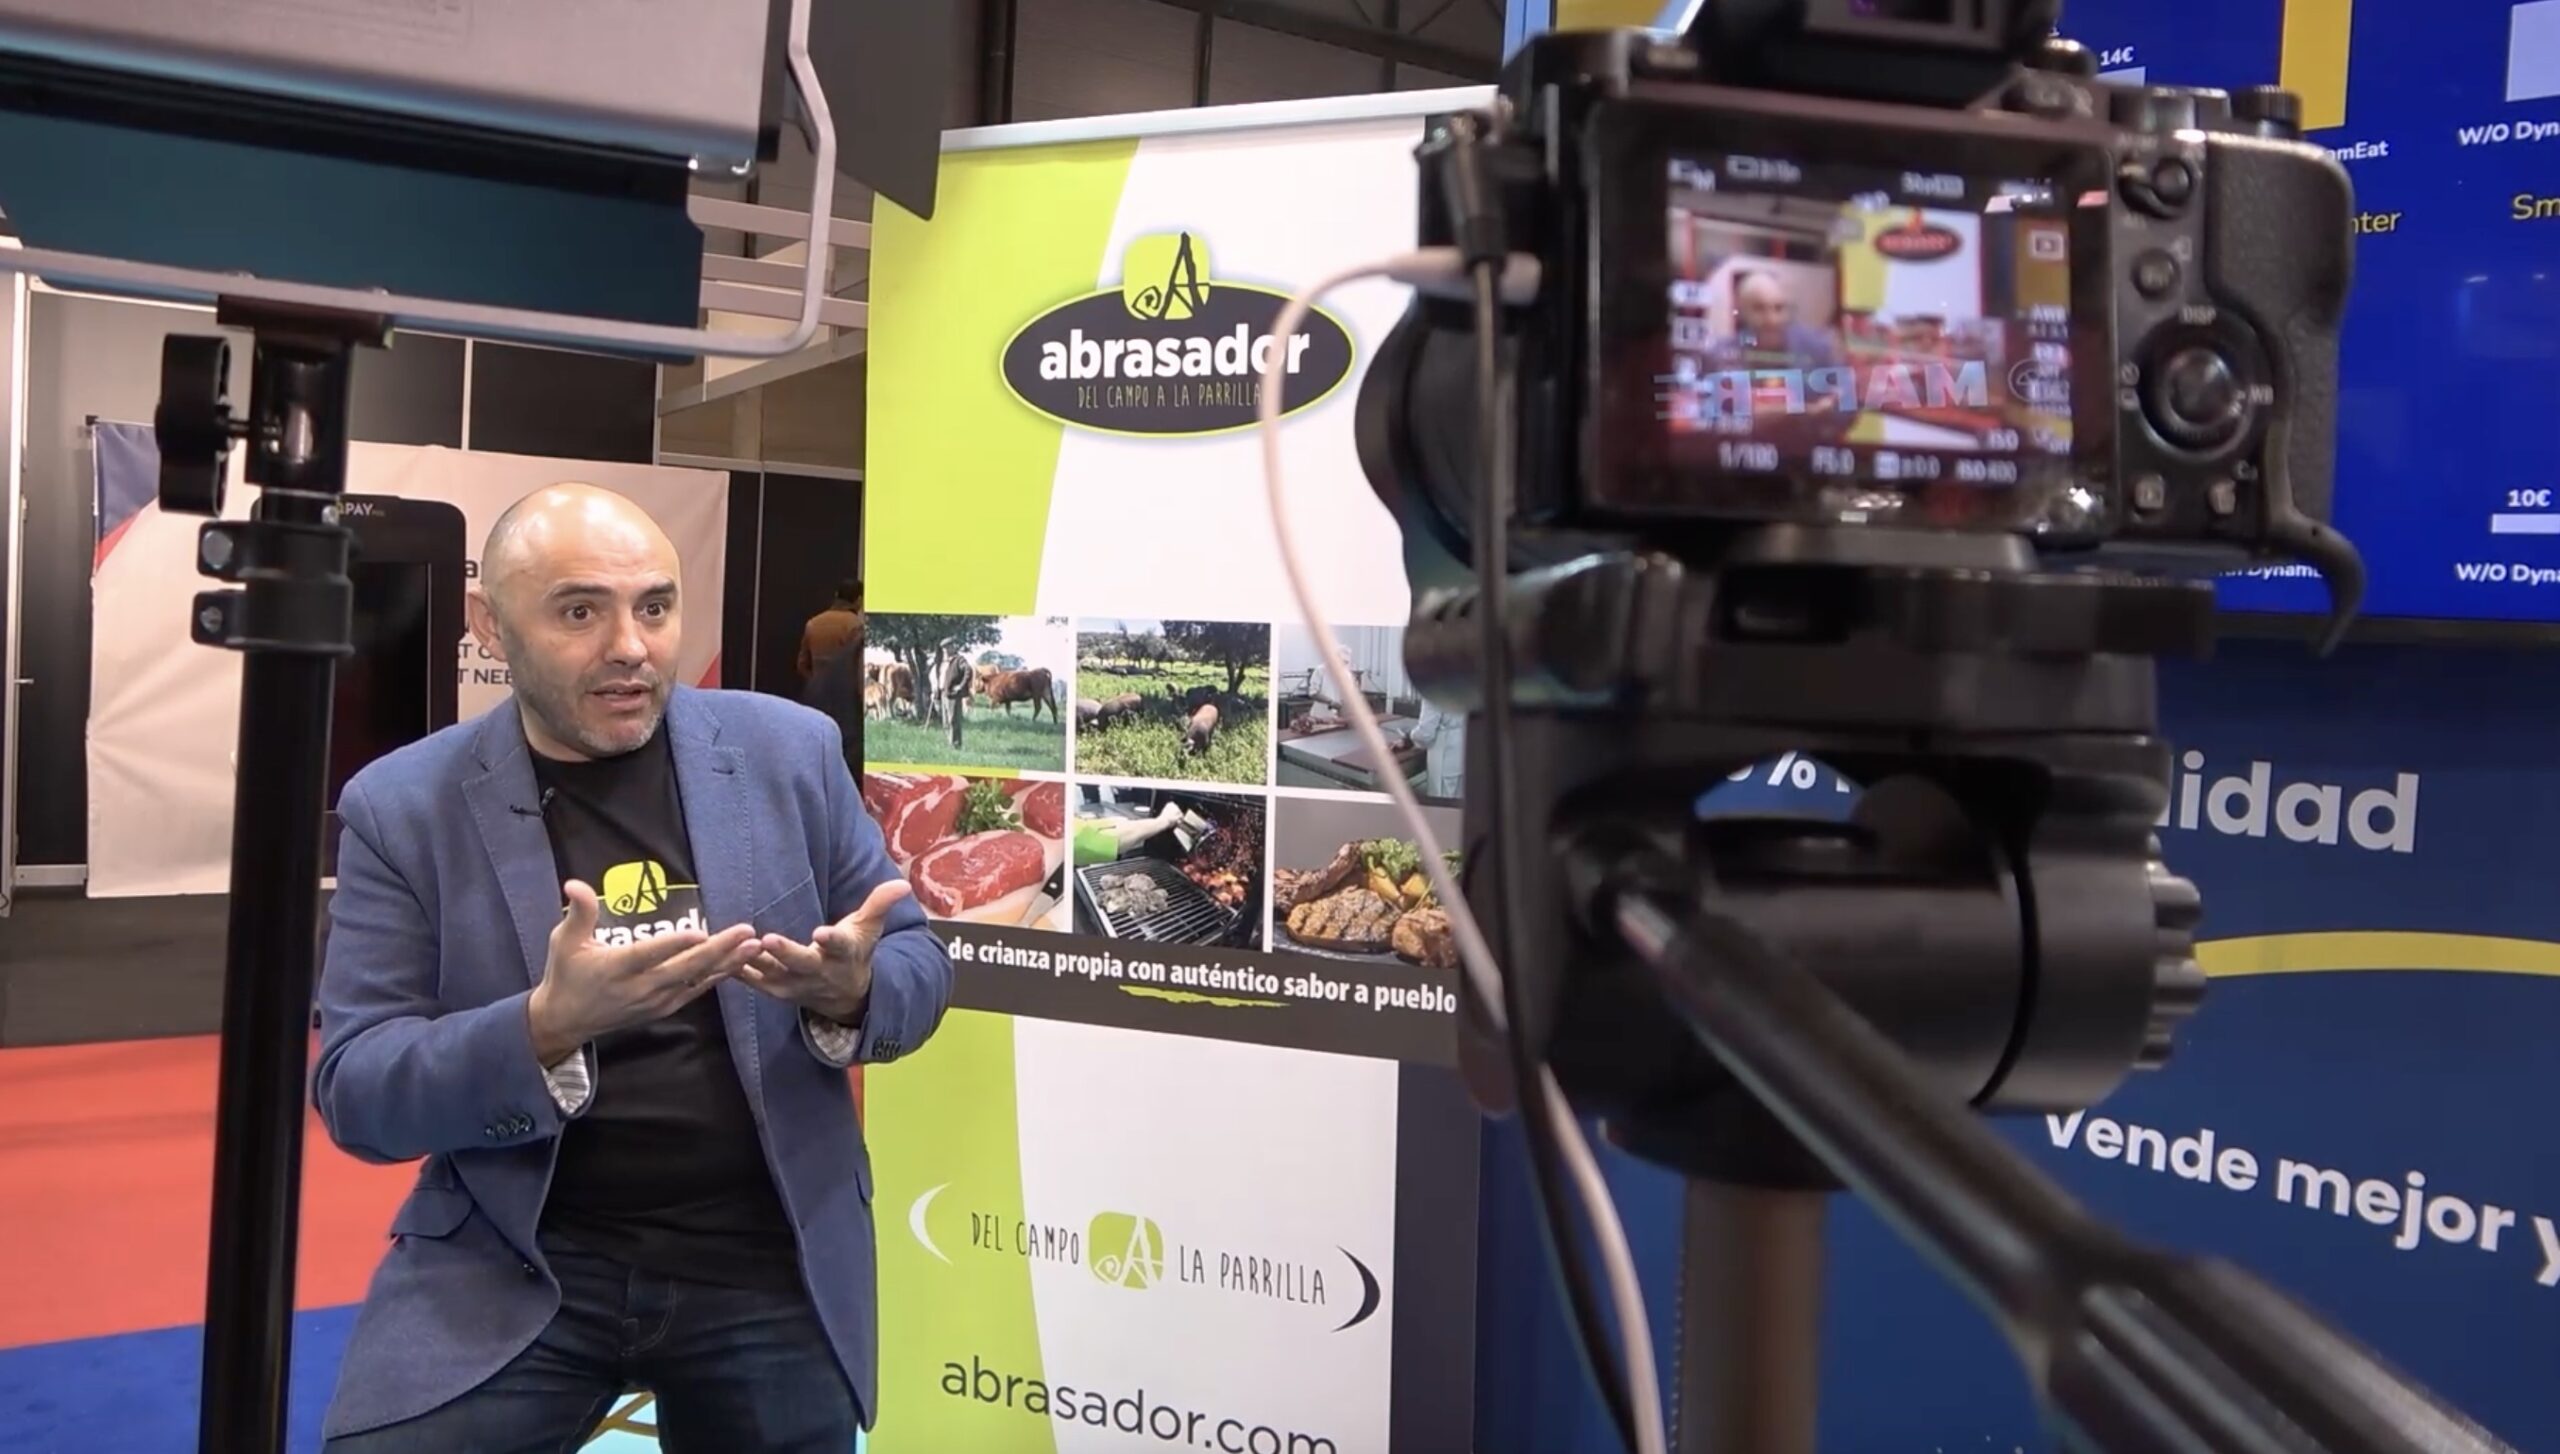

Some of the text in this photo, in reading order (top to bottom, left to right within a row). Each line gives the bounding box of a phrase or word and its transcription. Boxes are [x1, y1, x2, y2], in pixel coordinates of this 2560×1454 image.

[2099, 46, 2135, 66] 14€
[2458, 123, 2510, 146] W/O
[1038, 323, 1311, 381] abrasador
[1077, 380, 1264, 410] DEL CAMPO A LA PARRILLA
[2507, 489, 2552, 507] 10€
[2456, 562, 2507, 582] W/O
[594, 907, 709, 948] rasad
[949, 936, 1457, 1014] de crianza propia con auténtico sabor a pueblo
[2046, 1109, 2259, 1192] Vende
[2277, 1158, 2515, 1252] mejor
[971, 1212, 1003, 1252] DEL
[1016, 1221, 1080, 1265] CAMPO
[1180, 1245, 1205, 1284] LA
[1220, 1252, 1326, 1306] PARRILLA
[941, 1355, 1337, 1454] abrasador.com
